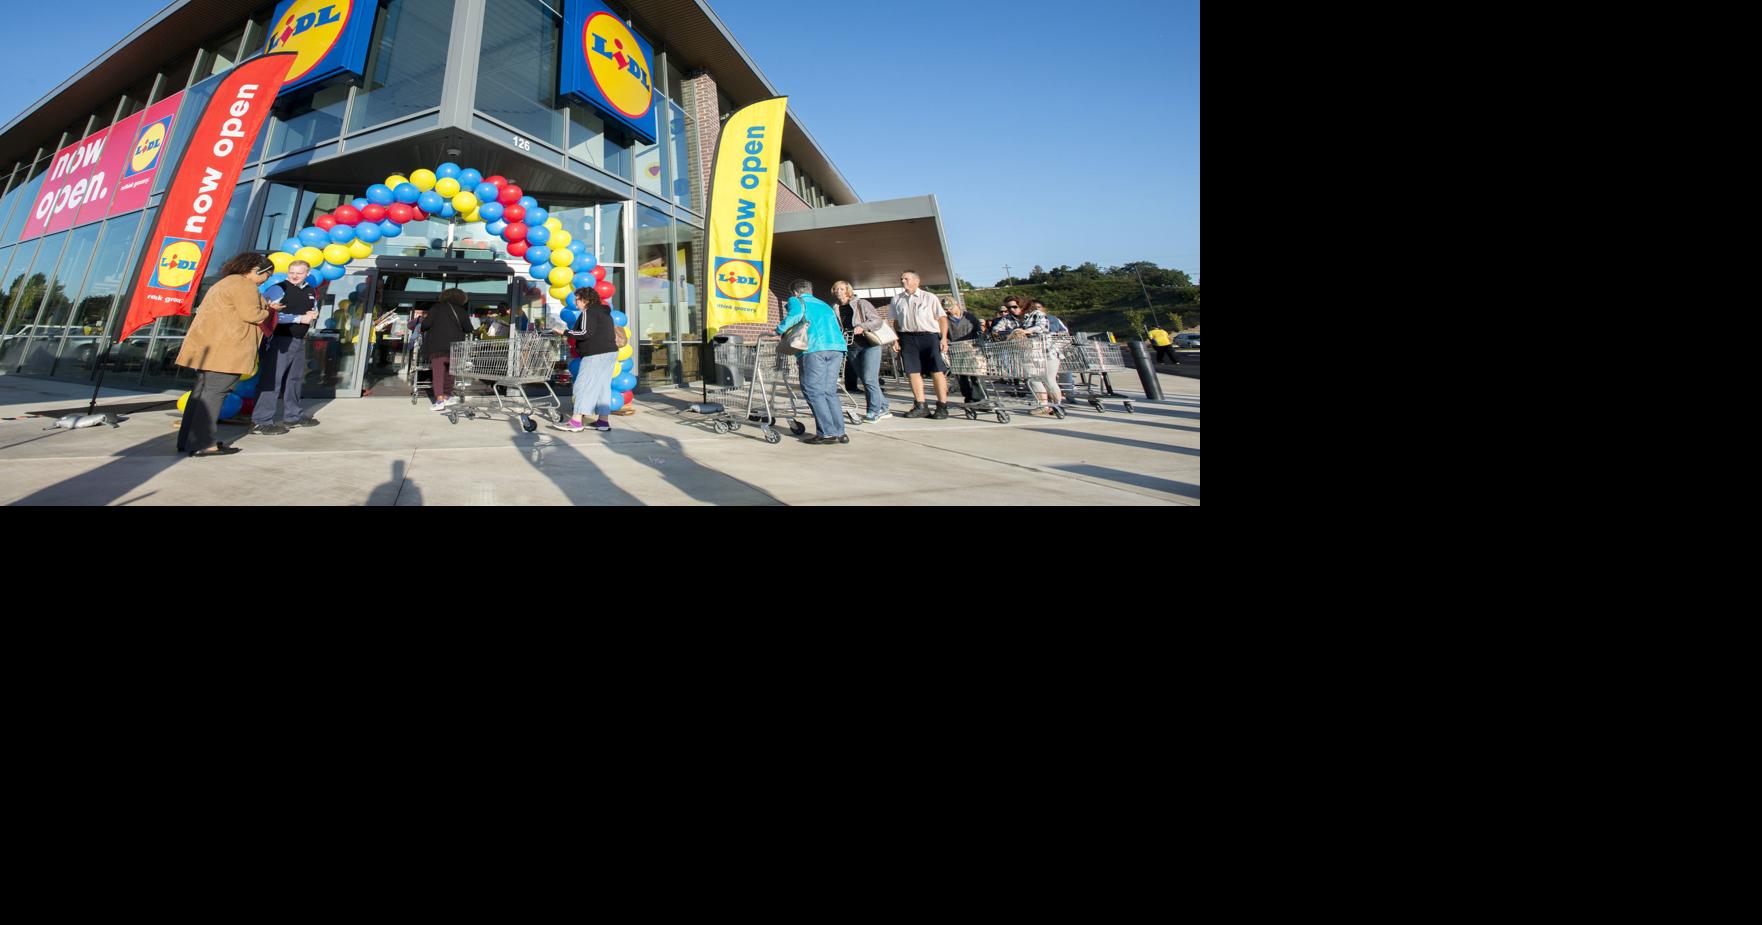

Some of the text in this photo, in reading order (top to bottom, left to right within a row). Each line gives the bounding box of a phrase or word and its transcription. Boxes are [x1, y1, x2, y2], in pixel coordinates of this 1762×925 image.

[50, 136, 108, 181] now
[184, 84, 260, 234] now open
[513, 136, 530, 151] 126
[733, 125, 768, 254] now open
